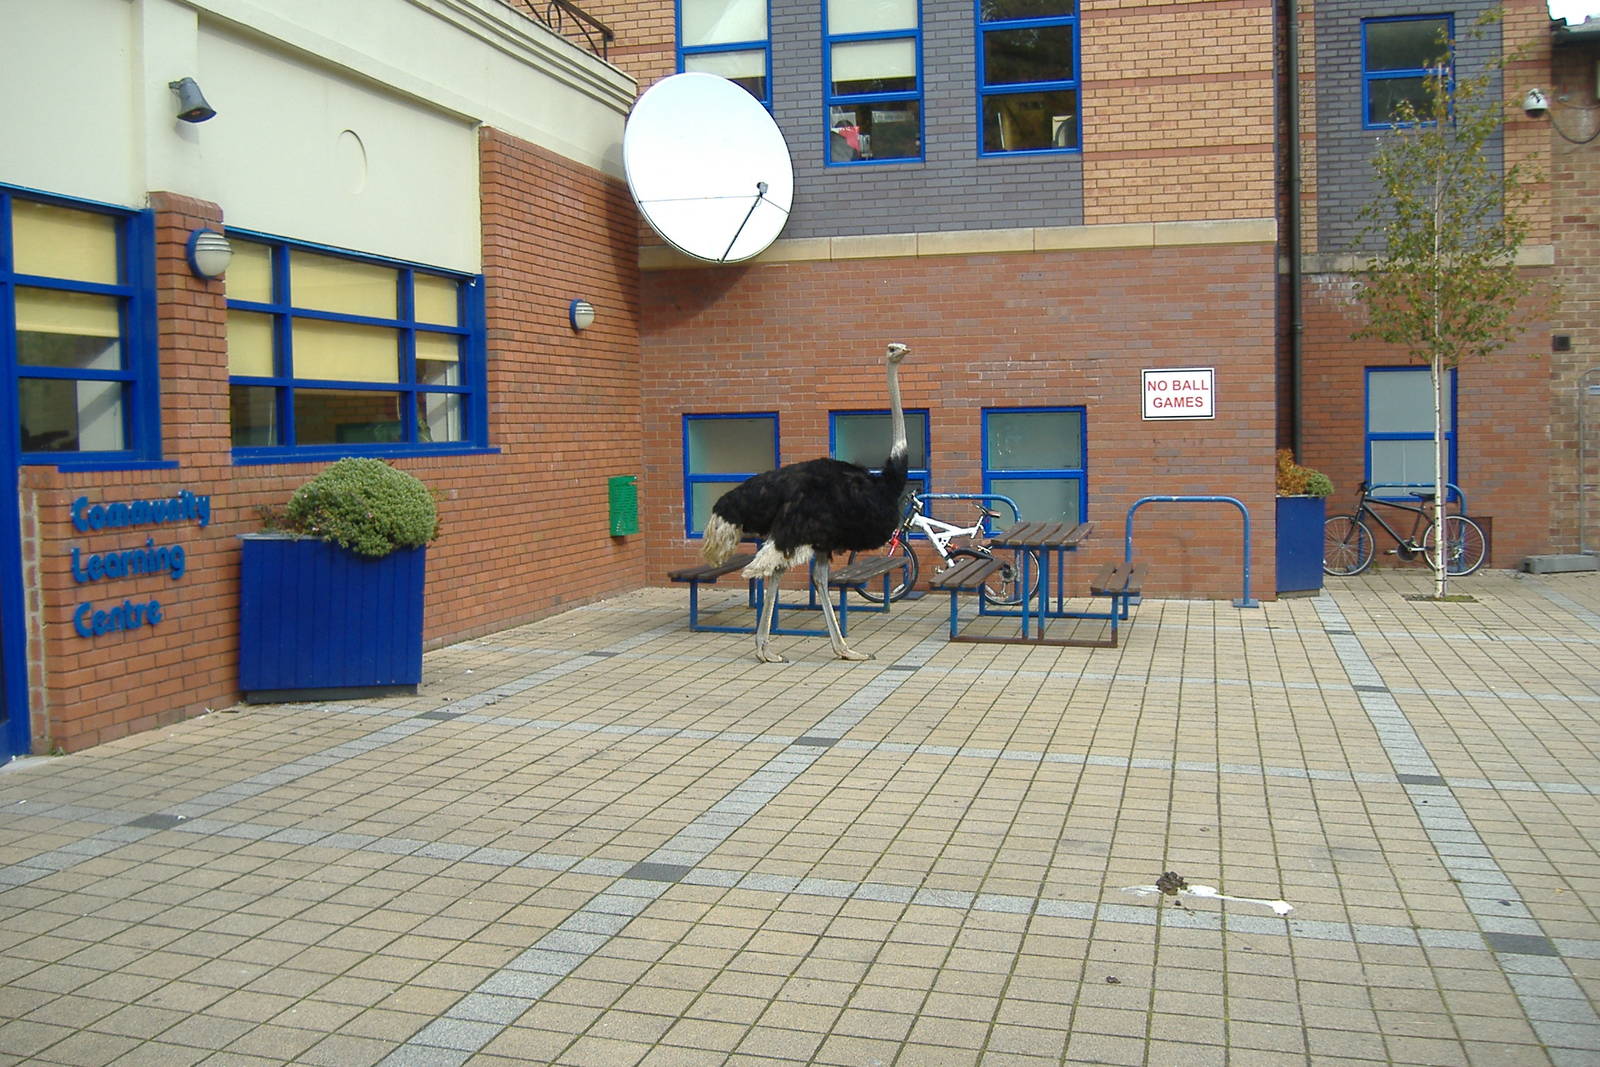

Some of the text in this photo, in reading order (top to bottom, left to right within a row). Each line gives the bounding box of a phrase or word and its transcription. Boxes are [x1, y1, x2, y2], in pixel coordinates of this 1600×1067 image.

[1147, 379, 1209, 391] NO BALL
[1153, 396, 1204, 408] GAMES
[70, 489, 210, 532] Community
[71, 538, 185, 583] Learning
[74, 600, 162, 638] Centre
